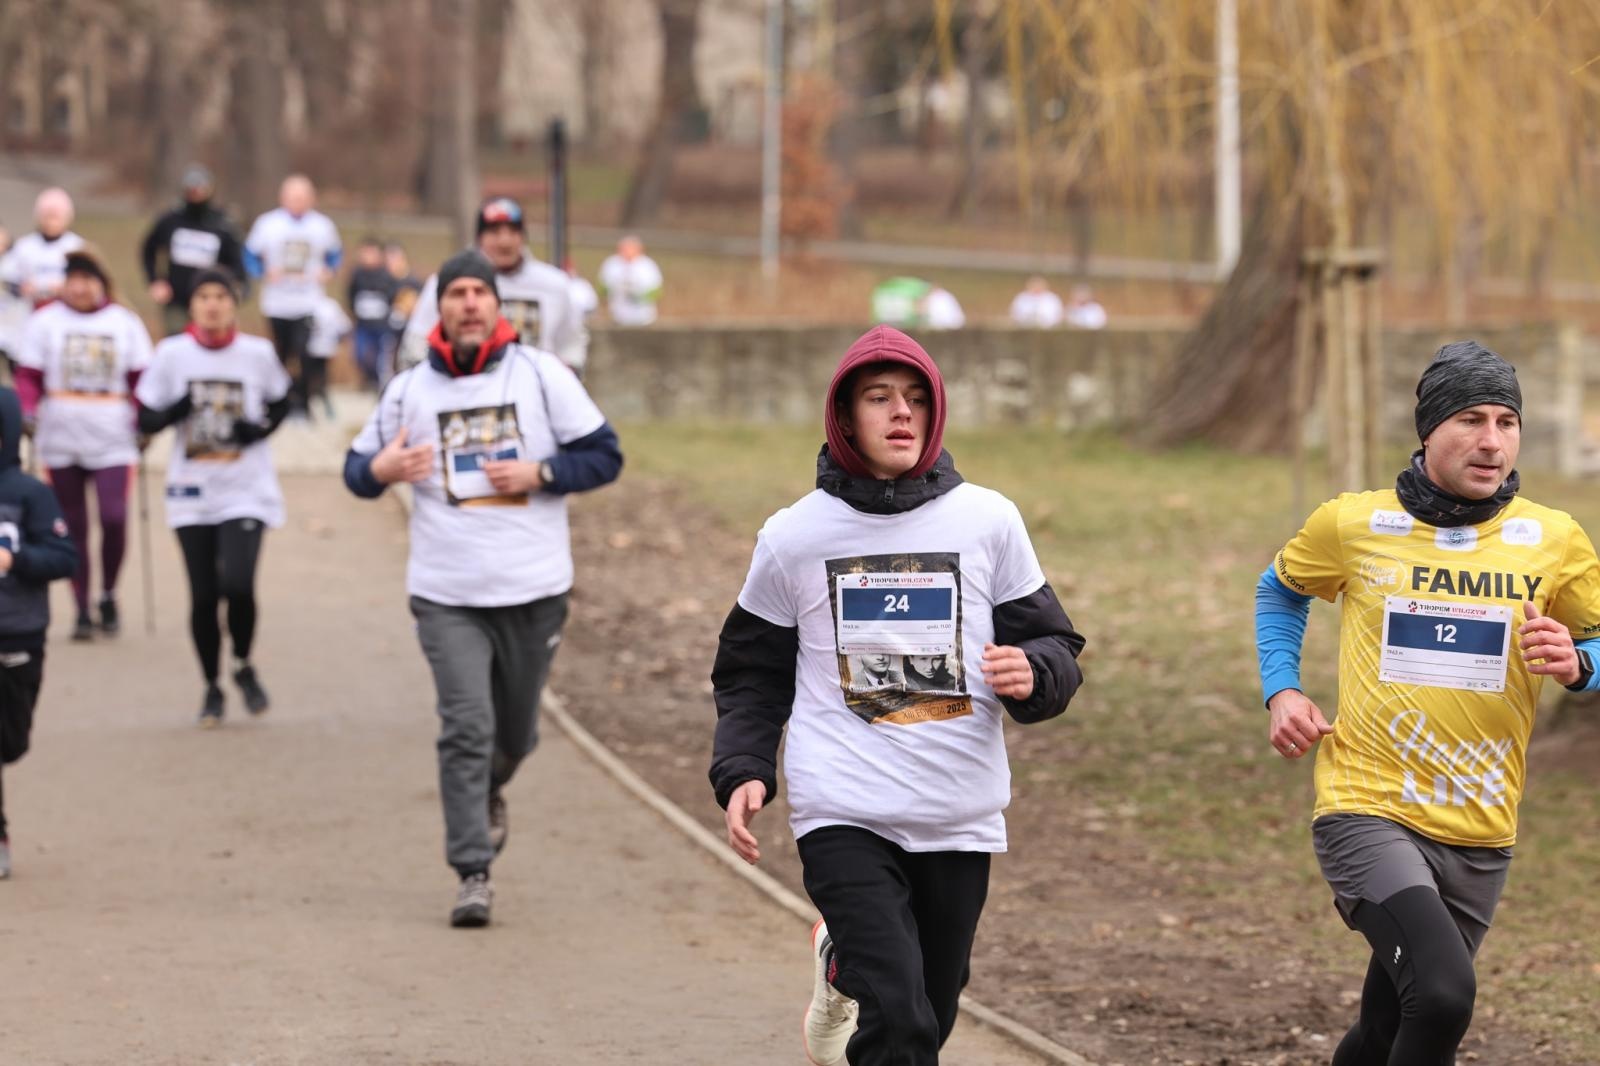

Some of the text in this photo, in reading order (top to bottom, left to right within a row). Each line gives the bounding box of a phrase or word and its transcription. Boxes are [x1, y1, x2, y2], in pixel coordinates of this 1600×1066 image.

[870, 576, 934, 584] TROPEM WILCZYM
[1411, 566, 1543, 602] FAMILY
[883, 594, 910, 613] 24
[1420, 604, 1451, 612] TROPEM
[1452, 607, 1487, 615] WILCZYM
[1434, 623, 1457, 644] 12
[946, 701, 967, 715] 2025
[1401, 769, 1506, 808] LIFE
